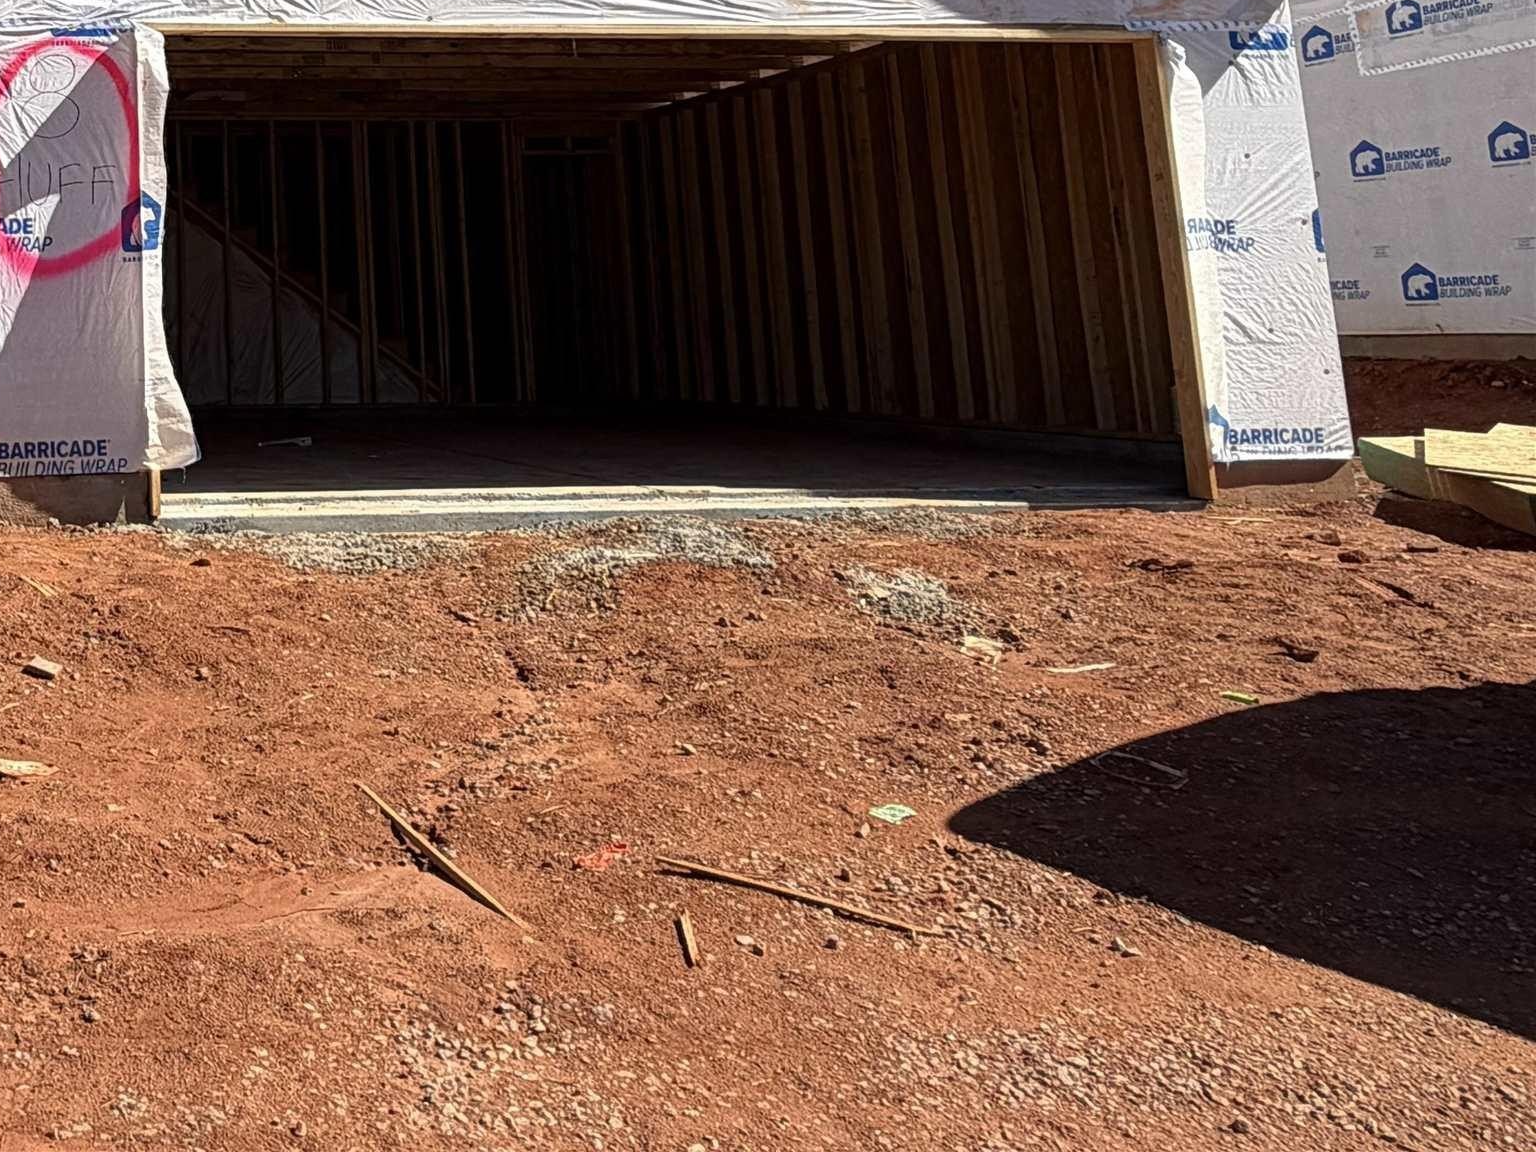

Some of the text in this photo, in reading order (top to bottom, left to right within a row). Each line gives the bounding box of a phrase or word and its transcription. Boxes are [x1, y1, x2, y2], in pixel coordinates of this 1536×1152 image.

[1424, 3, 1493, 26] BUILDING WRAP
[1385, 147, 1440, 162] BARRICADE
[1386, 156, 1452, 172] BUILDING WRAP
[8, 237, 53, 253] WRAP
[1439, 274, 1499, 287] BARRICADE
[1440, 286, 1512, 298] BUILDING WRAP
[1228, 428, 1324, 445] BARRICADE
[81, 458, 127, 474] WRAP
